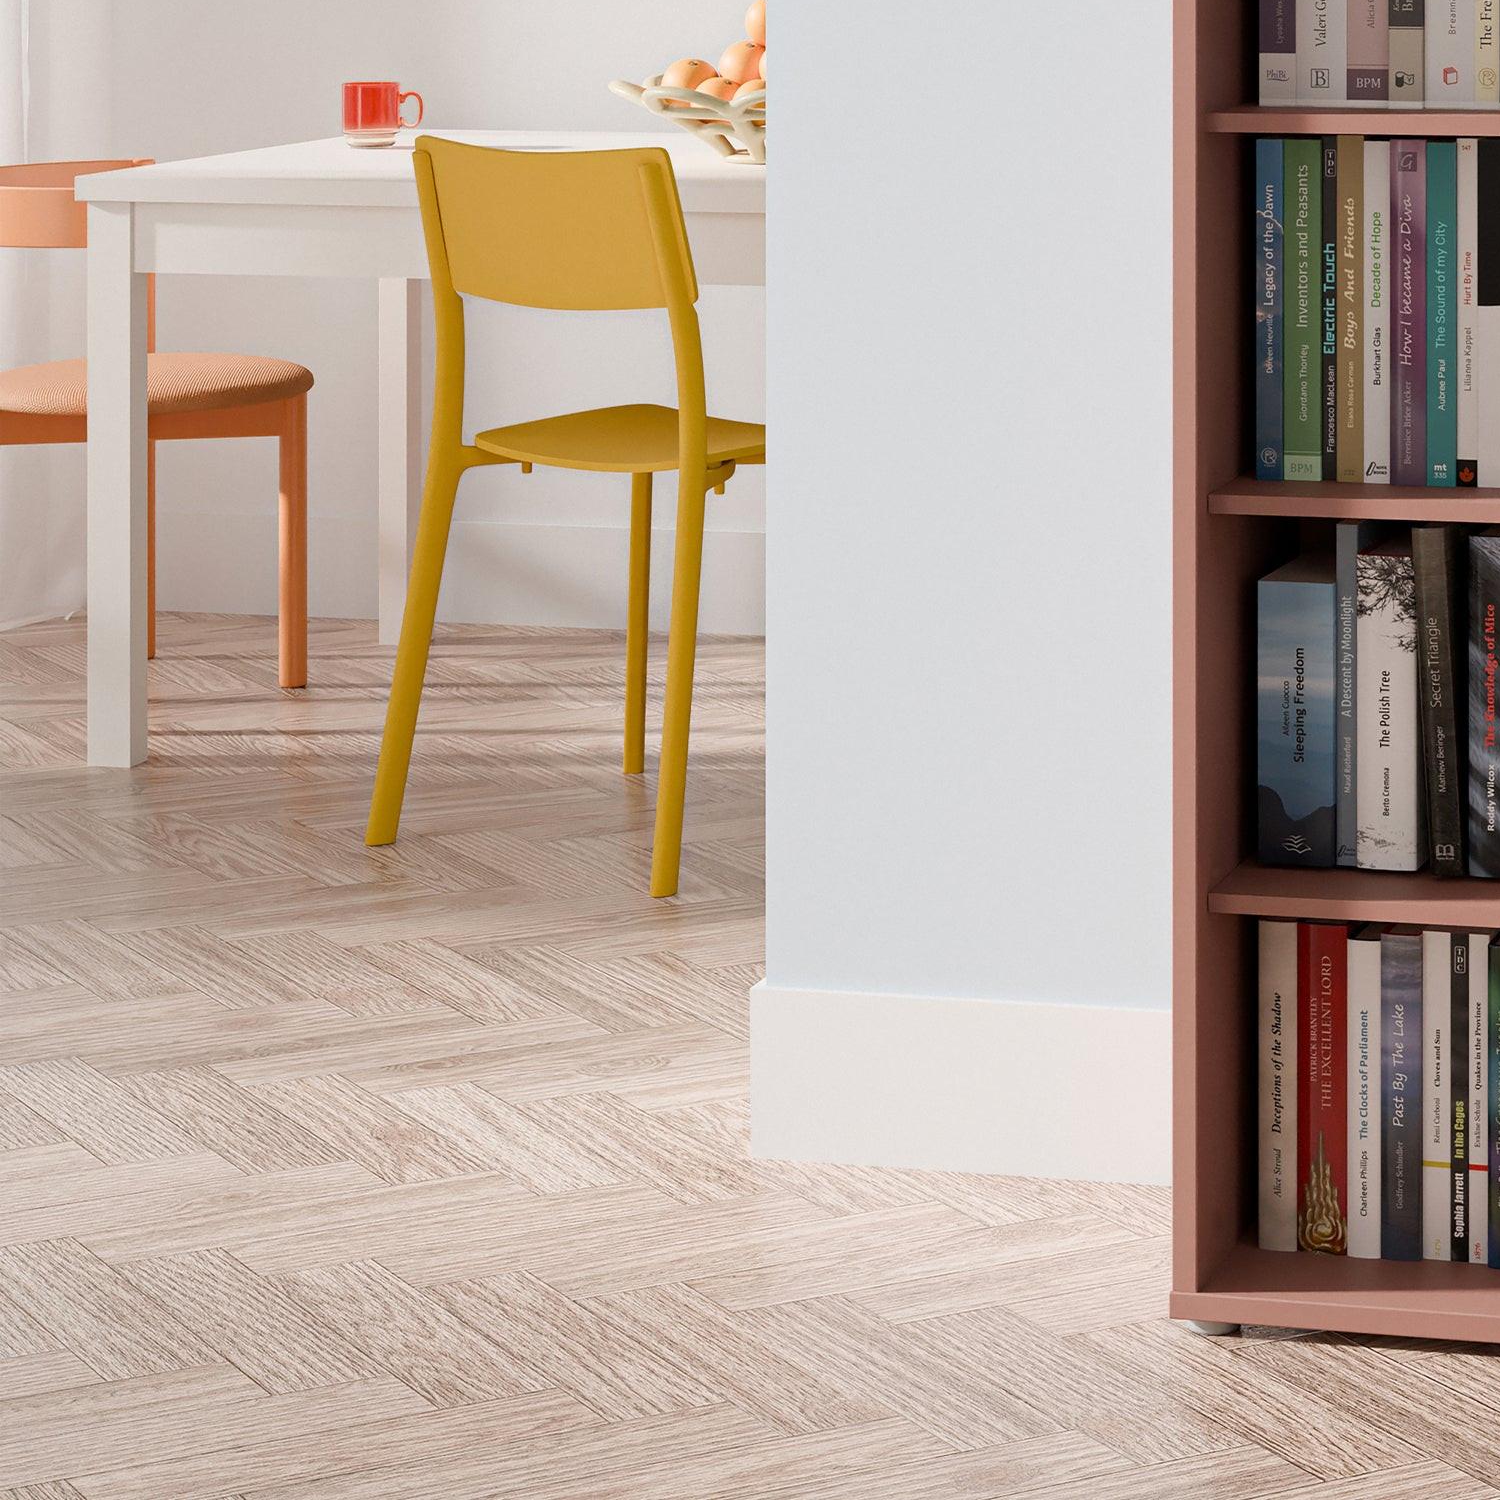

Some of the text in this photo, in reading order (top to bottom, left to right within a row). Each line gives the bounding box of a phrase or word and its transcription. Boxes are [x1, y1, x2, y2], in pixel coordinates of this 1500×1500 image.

[1313, 15, 1327, 46] Valeri
[1357, 78, 1380, 89] BPM
[1295, 165, 1309, 327] Inventors and Peasants
[1343, 198, 1358, 348] Boys And Friends
[1370, 212, 1383, 307] Decade of Hope
[1434, 222, 1448, 348] The Sound of my City
[1322, 244, 1337, 355] Electric Touch
[1326, 366, 1337, 452] Francesco MacLean
[1436, 360, 1447, 411] Aubree Paul
[1340, 596, 1354, 649] Moonlight
[1340, 652, 1354, 663] by
[1293, 648, 1307, 762] Sleeping Freedom
[1340, 667, 1352, 706] Descent
[1378, 671, 1391, 747] The Polish Tree
[1382, 768, 1390, 816] Berto Cremona
[1485, 765, 1497, 832] Roddy Wilcox
[1270, 993, 1284, 1133] Deceptions of the Shadow
[1321, 956, 1332, 1110] THE EXCELLENT LORD
[1358, 1011, 1369, 1139] The Clocks of Parliament
[1391, 1005, 1408, 1126] Past By The Lake
[1453, 1171, 1467, 1238] Sophia Jarrett
